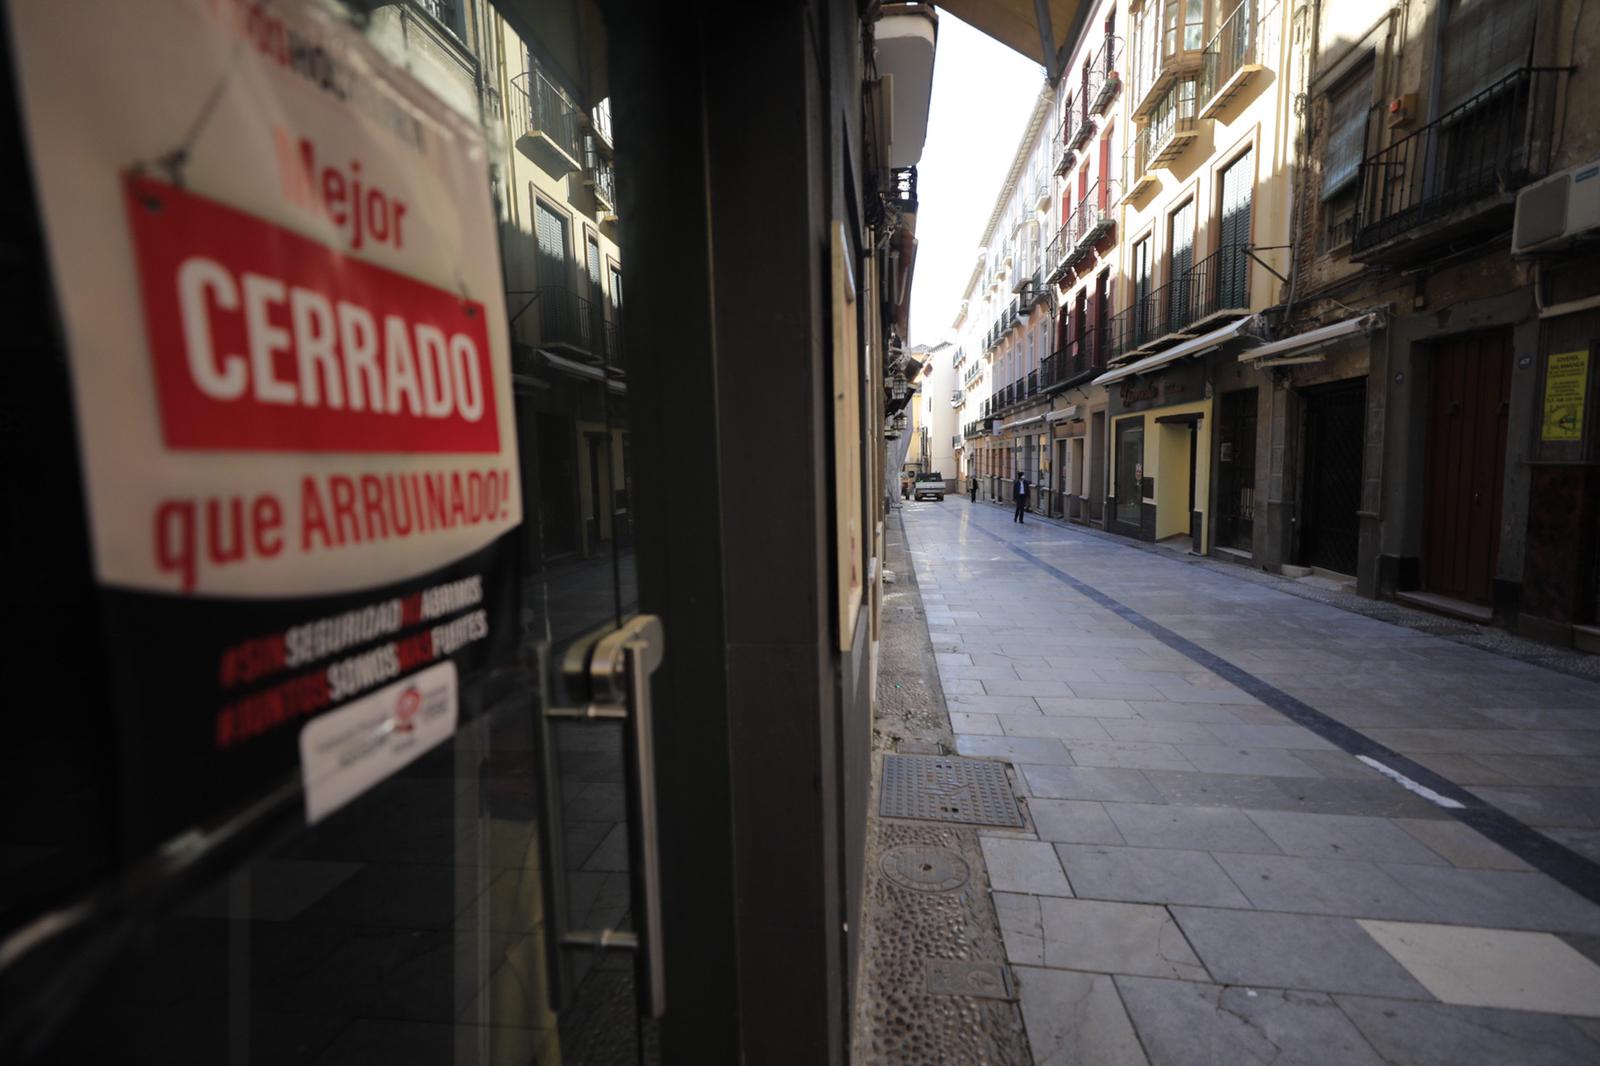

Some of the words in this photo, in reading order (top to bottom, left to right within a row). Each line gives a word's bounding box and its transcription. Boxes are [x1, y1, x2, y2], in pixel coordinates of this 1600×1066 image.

[276, 124, 408, 250] Mejor
[176, 256, 485, 423] CERRADO
[153, 491, 285, 595] que
[301, 469, 510, 552] ARRUINADO!
